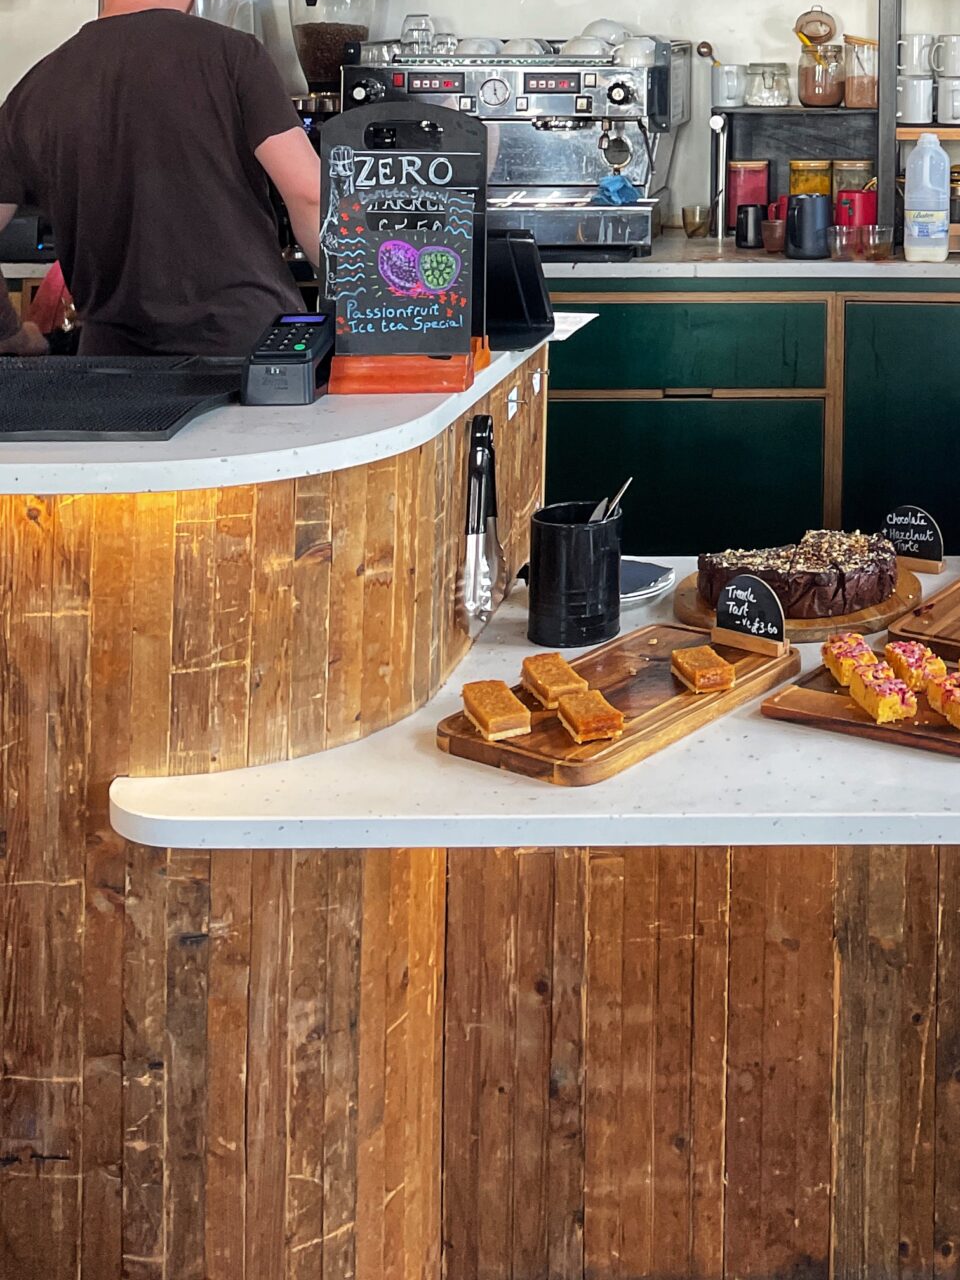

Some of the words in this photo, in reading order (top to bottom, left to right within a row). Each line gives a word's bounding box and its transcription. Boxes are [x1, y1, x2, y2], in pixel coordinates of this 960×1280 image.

[353, 156, 453, 186] ZERO
[346, 299, 440, 320] Passionfruit
[349, 322, 375, 333] Ice
[381, 321, 408, 331] tea
[414, 316, 464, 334] Special
[886, 511, 927, 525] Chocolate
[726, 601, 749, 617] Tart
